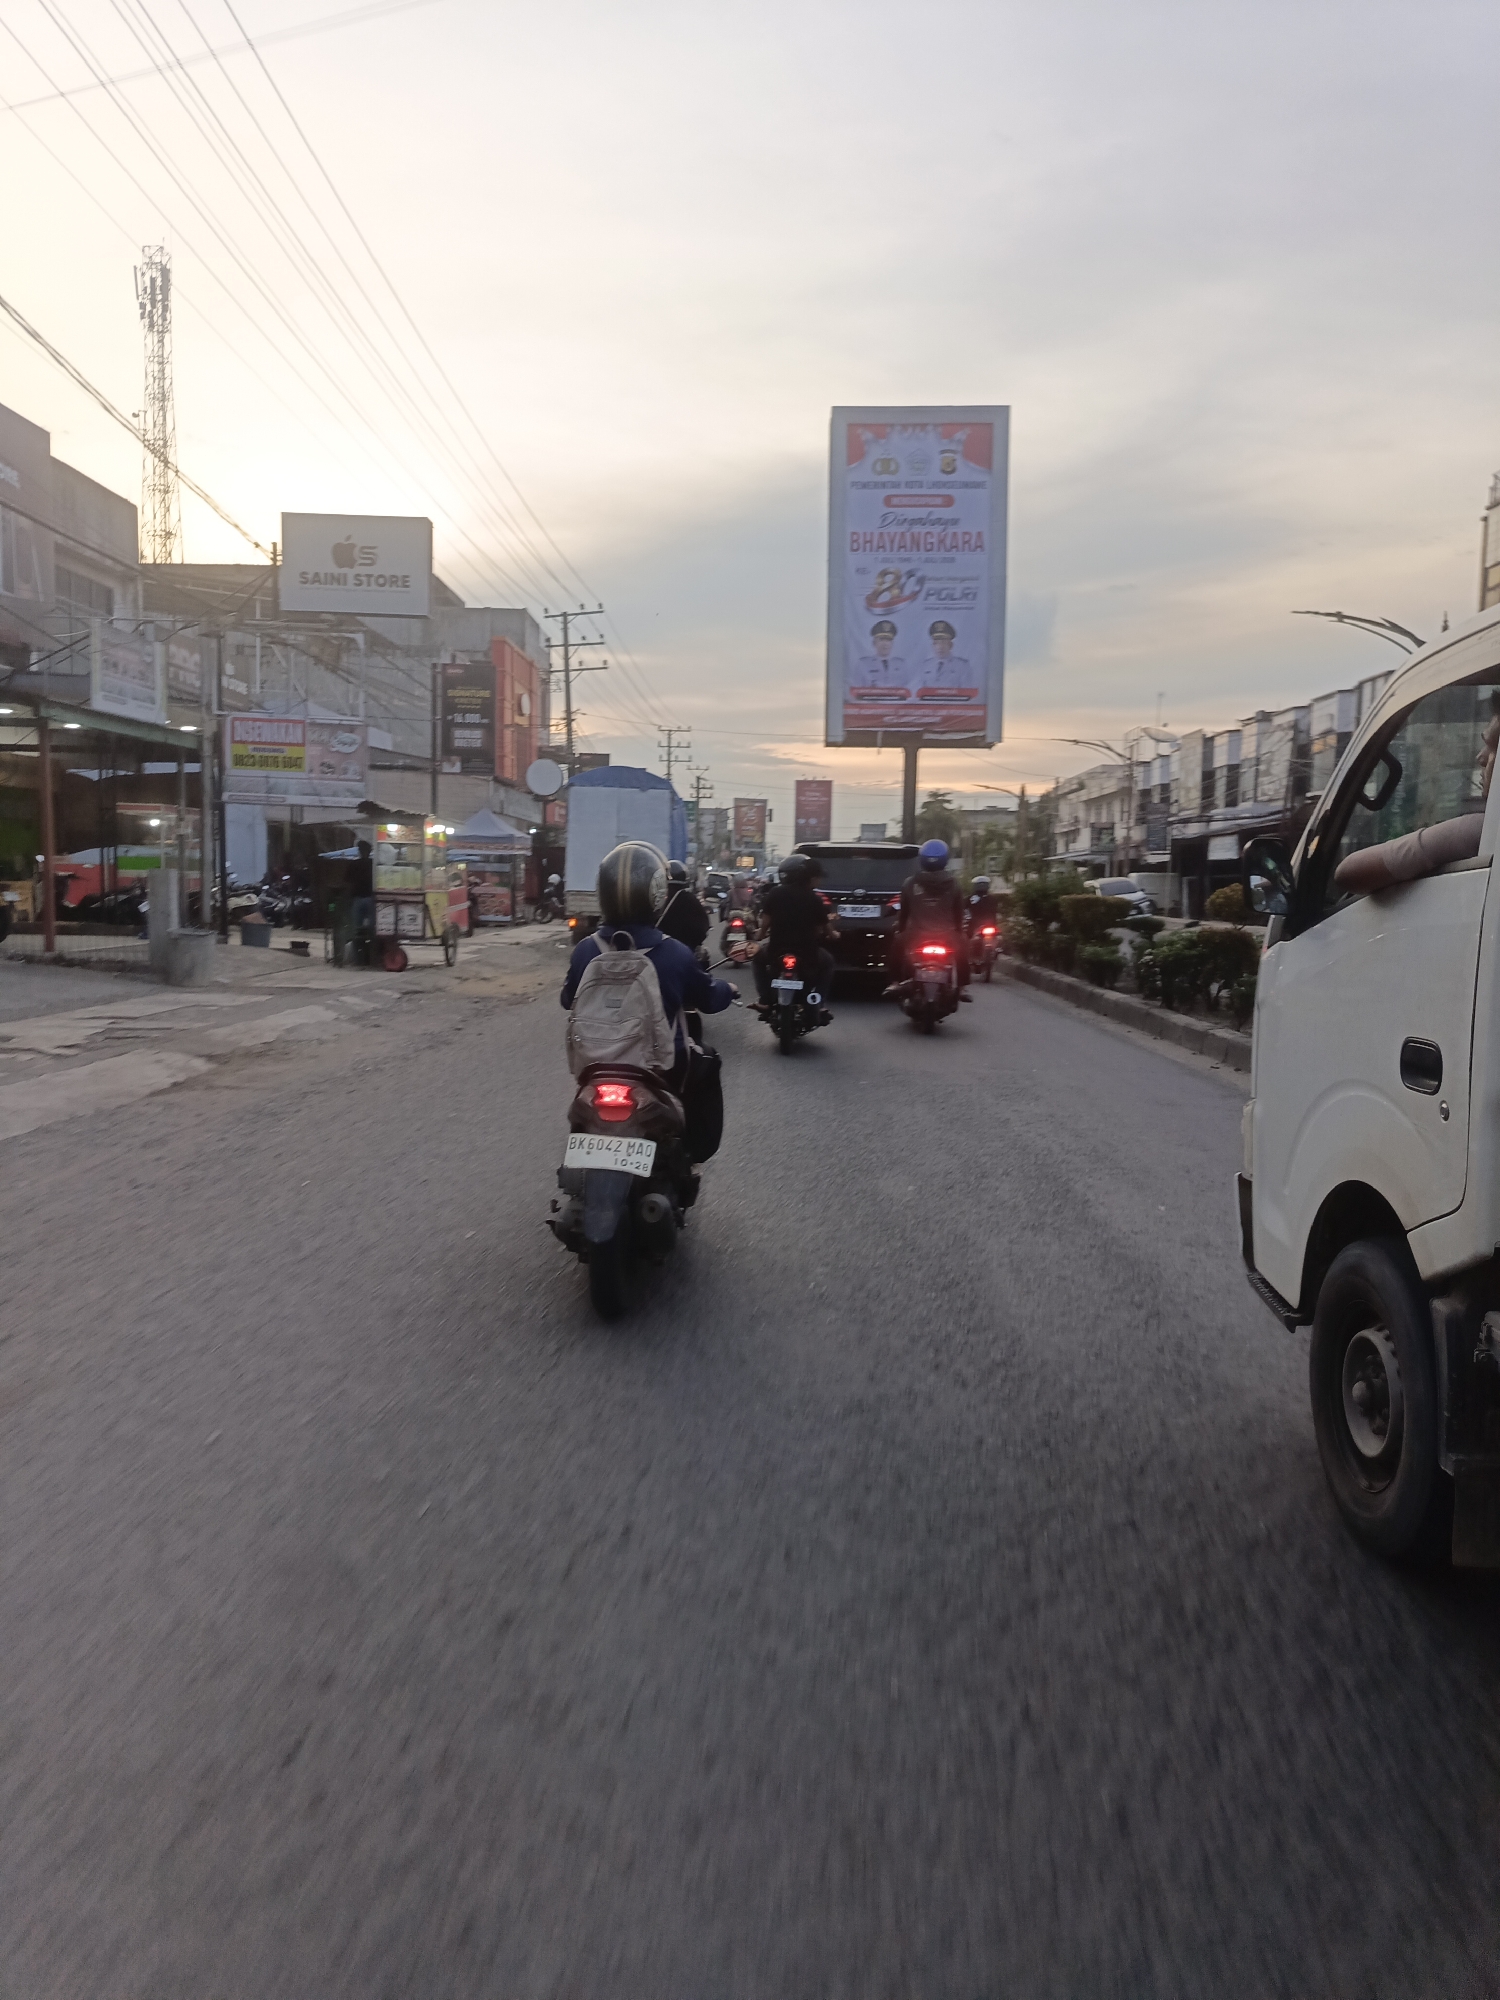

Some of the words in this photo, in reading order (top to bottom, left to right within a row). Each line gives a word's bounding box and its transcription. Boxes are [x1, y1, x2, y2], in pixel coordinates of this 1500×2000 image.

[849, 531, 986, 553] BHAYANGKARA
[299, 571, 348, 587] SAINI
[353, 573, 411, 589] STORE
